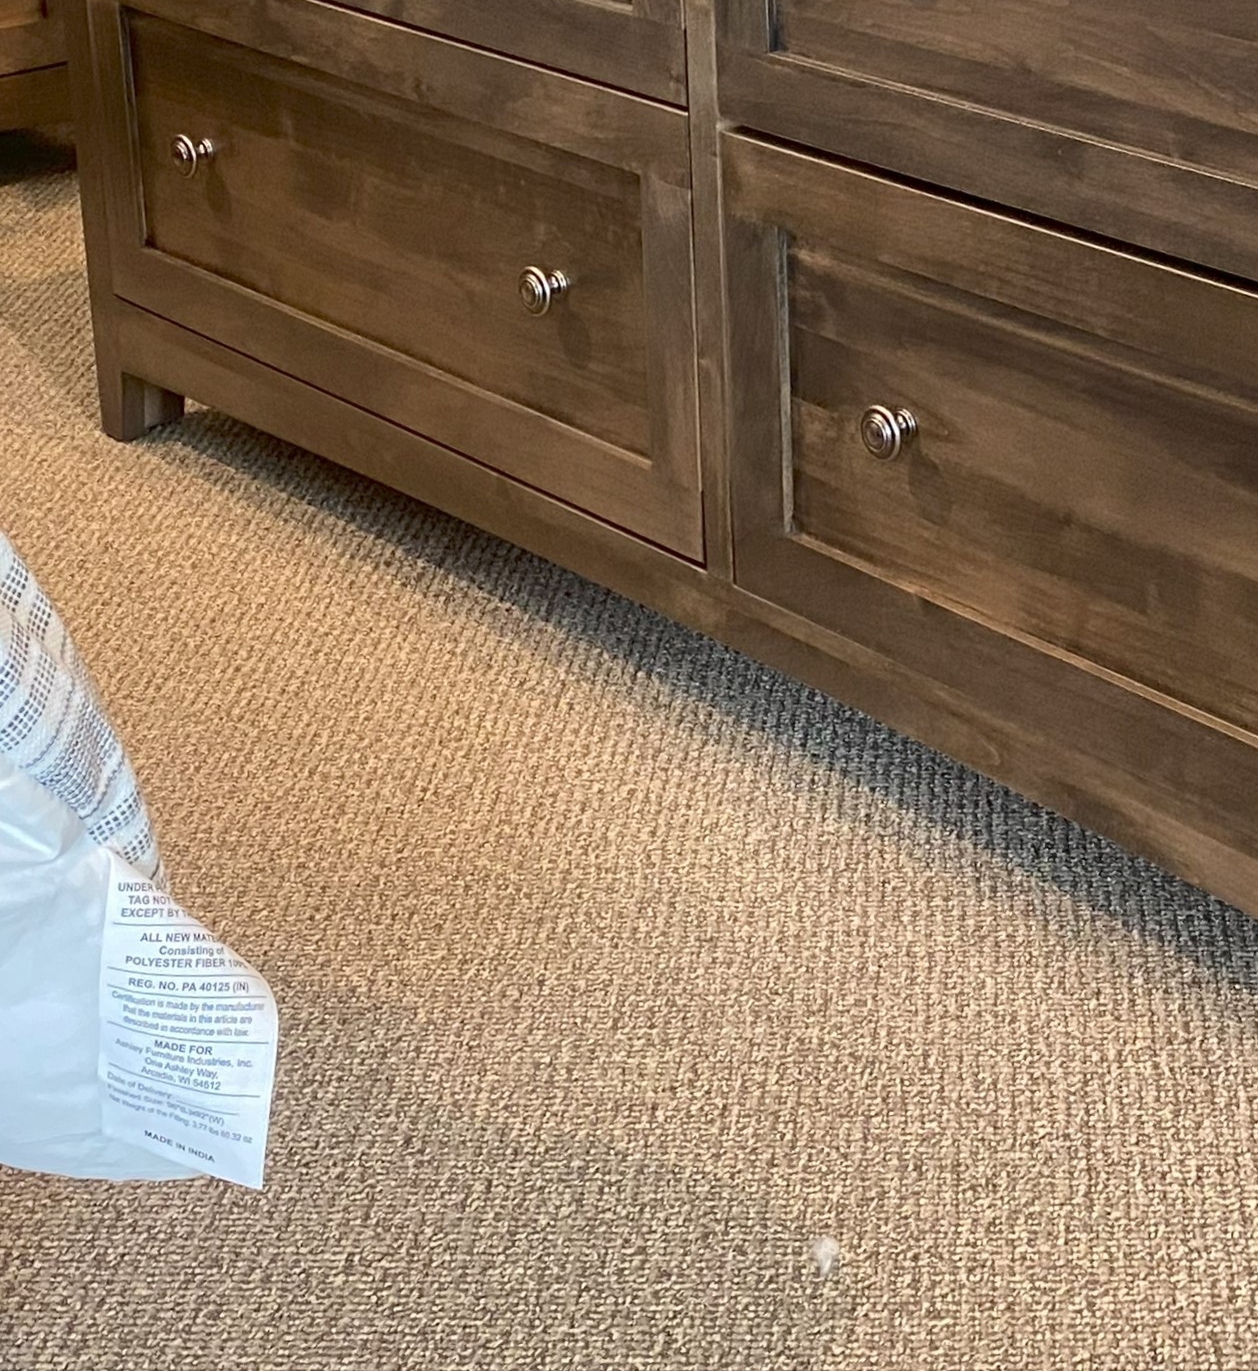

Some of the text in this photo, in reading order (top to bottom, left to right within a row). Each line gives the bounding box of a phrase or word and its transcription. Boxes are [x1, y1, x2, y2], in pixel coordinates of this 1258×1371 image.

[117, 882, 154, 893] UNDER
[128, 895, 150, 905] TAG
[120, 908, 165, 918] EXCEPT
[167, 909, 180, 918] BY
[140, 933, 163, 943] ALL
[165, 933, 191, 943] NEW
[159, 945, 214, 957] Consisting
[125, 956, 193, 969] POLYESTER
[195, 958, 226, 968] FIBER
[128, 977, 250, 993] REG. NO. PA 40125 (IN)
[111, 990, 156, 1006] Certification
[166, 1000, 189, 1010] made
[189, 1002, 200, 1013] by
[115, 1038, 144, 1054] Ashley
[145, 1047, 185, 1063] Furniture
[154, 1039, 214, 1056] MADE FOR
[144, 1057, 163, 1069] One
[164, 1062, 195, 1077] Ashley
[178, 1074, 191, 1086] WI
[143, 1129, 216, 1164] MADE IN INDIA
